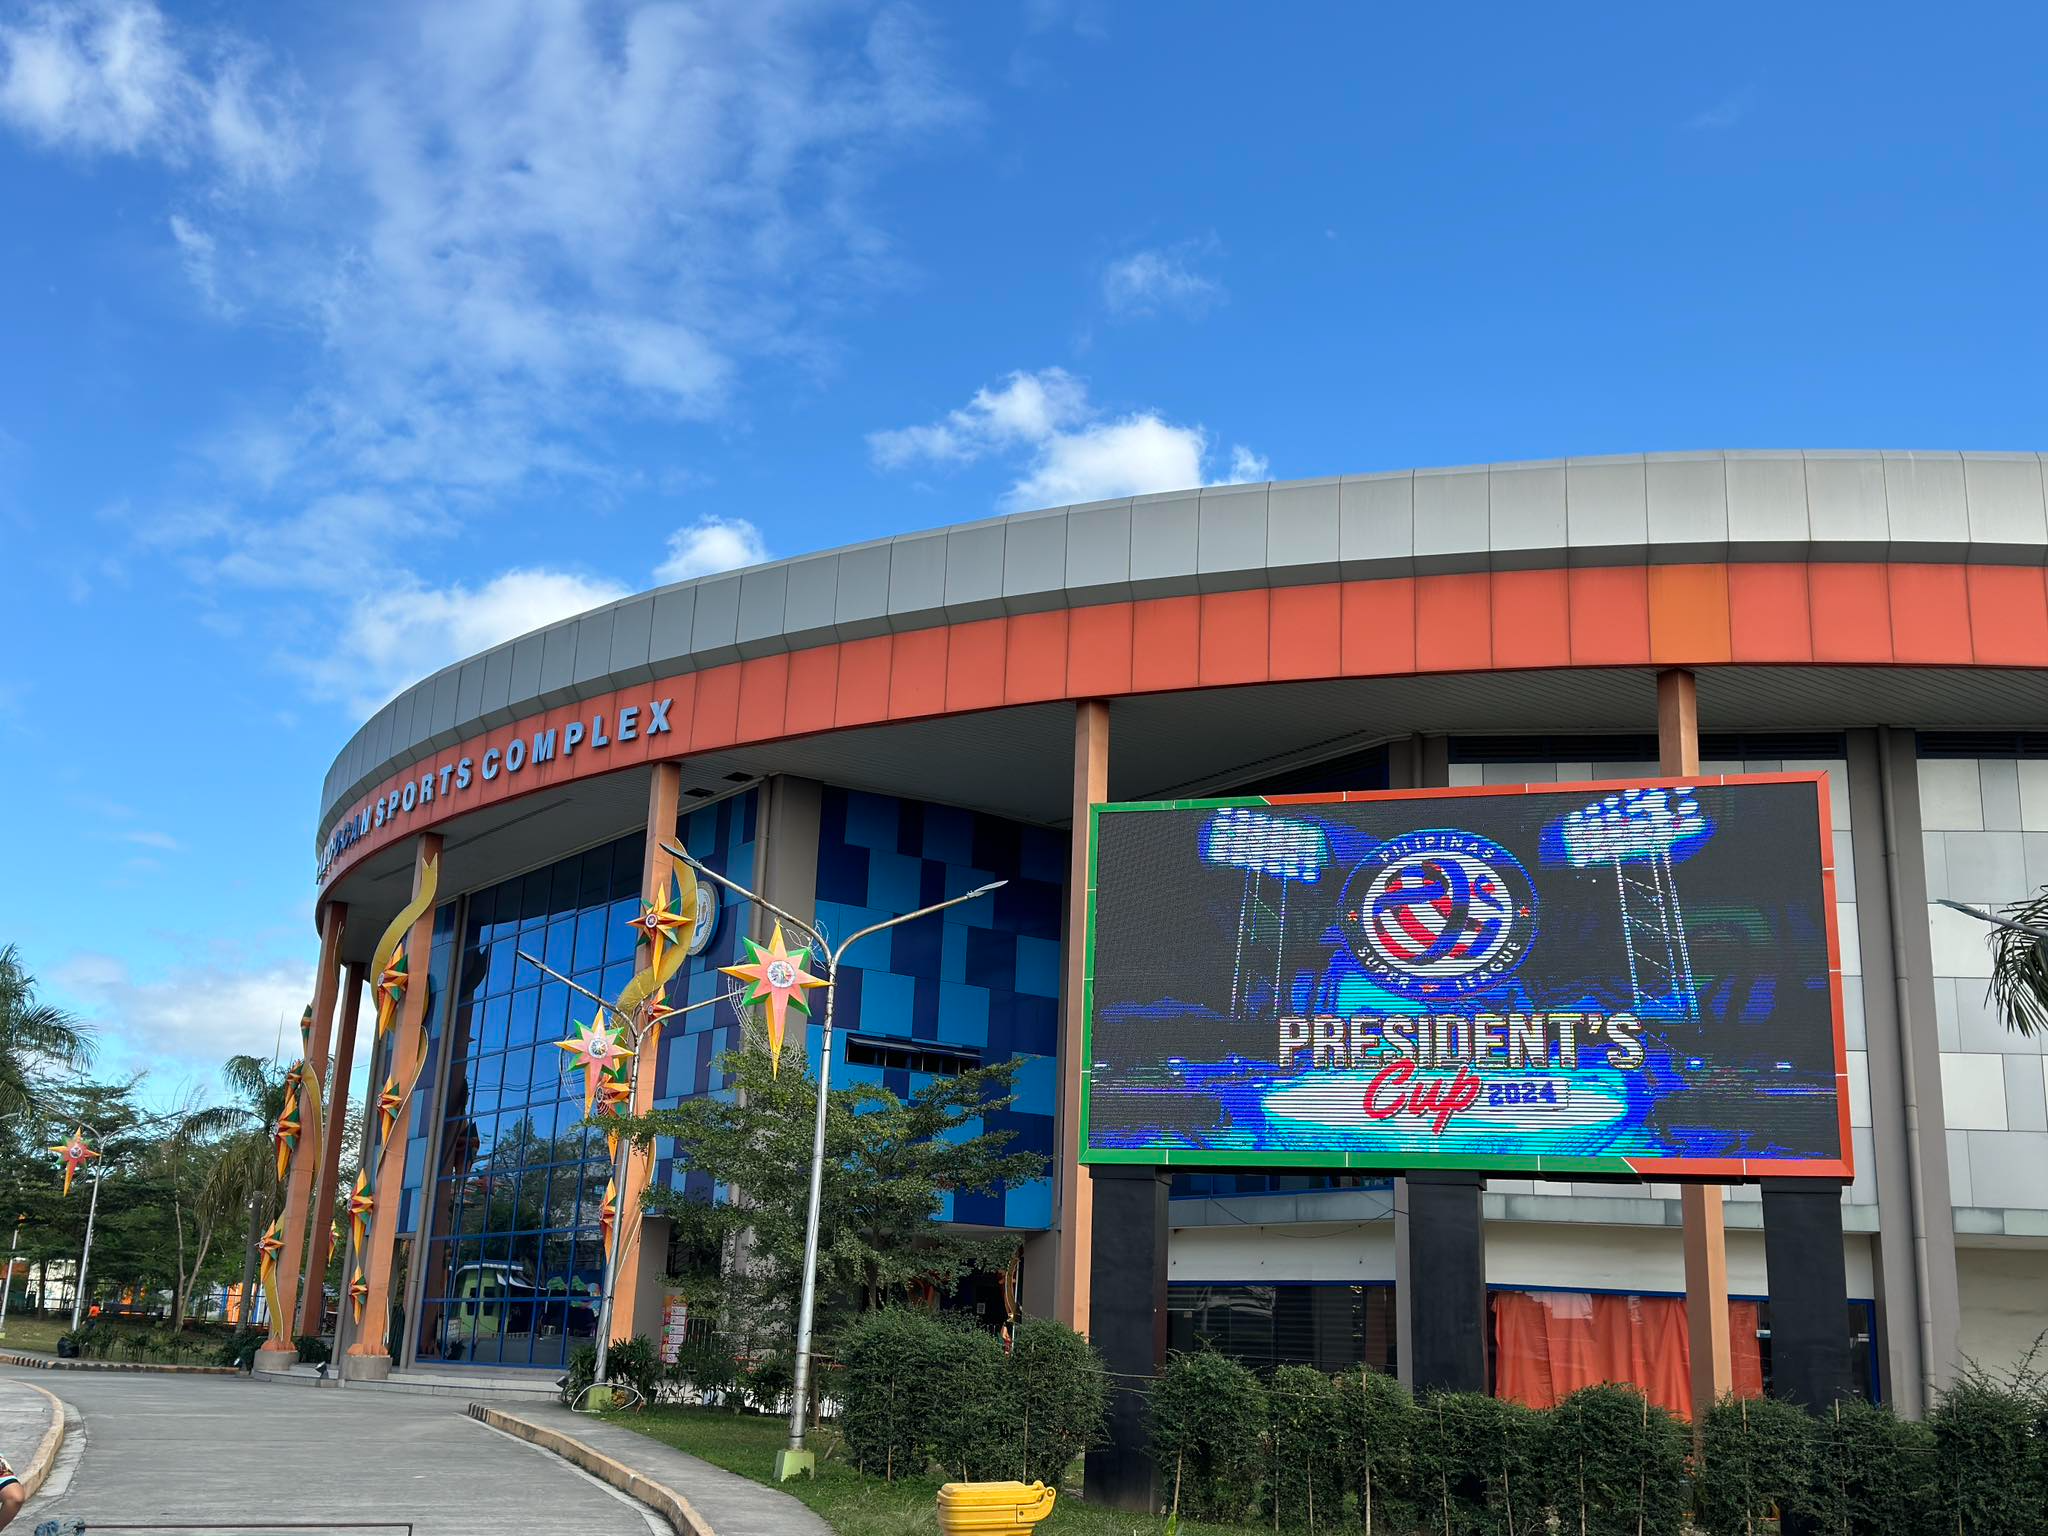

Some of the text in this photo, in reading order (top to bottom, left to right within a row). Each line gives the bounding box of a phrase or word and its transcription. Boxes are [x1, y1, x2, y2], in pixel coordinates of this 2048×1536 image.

[374, 757, 473, 827] SPORTS
[481, 698, 673, 781] COMPLEX
[1378, 836, 1495, 862] PILIPINAS
[1357, 946, 1411, 988] SUPER
[1278, 1013, 1646, 1070] PRESIDENT'S
[1363, 1058, 1558, 1135] Cup 2024
